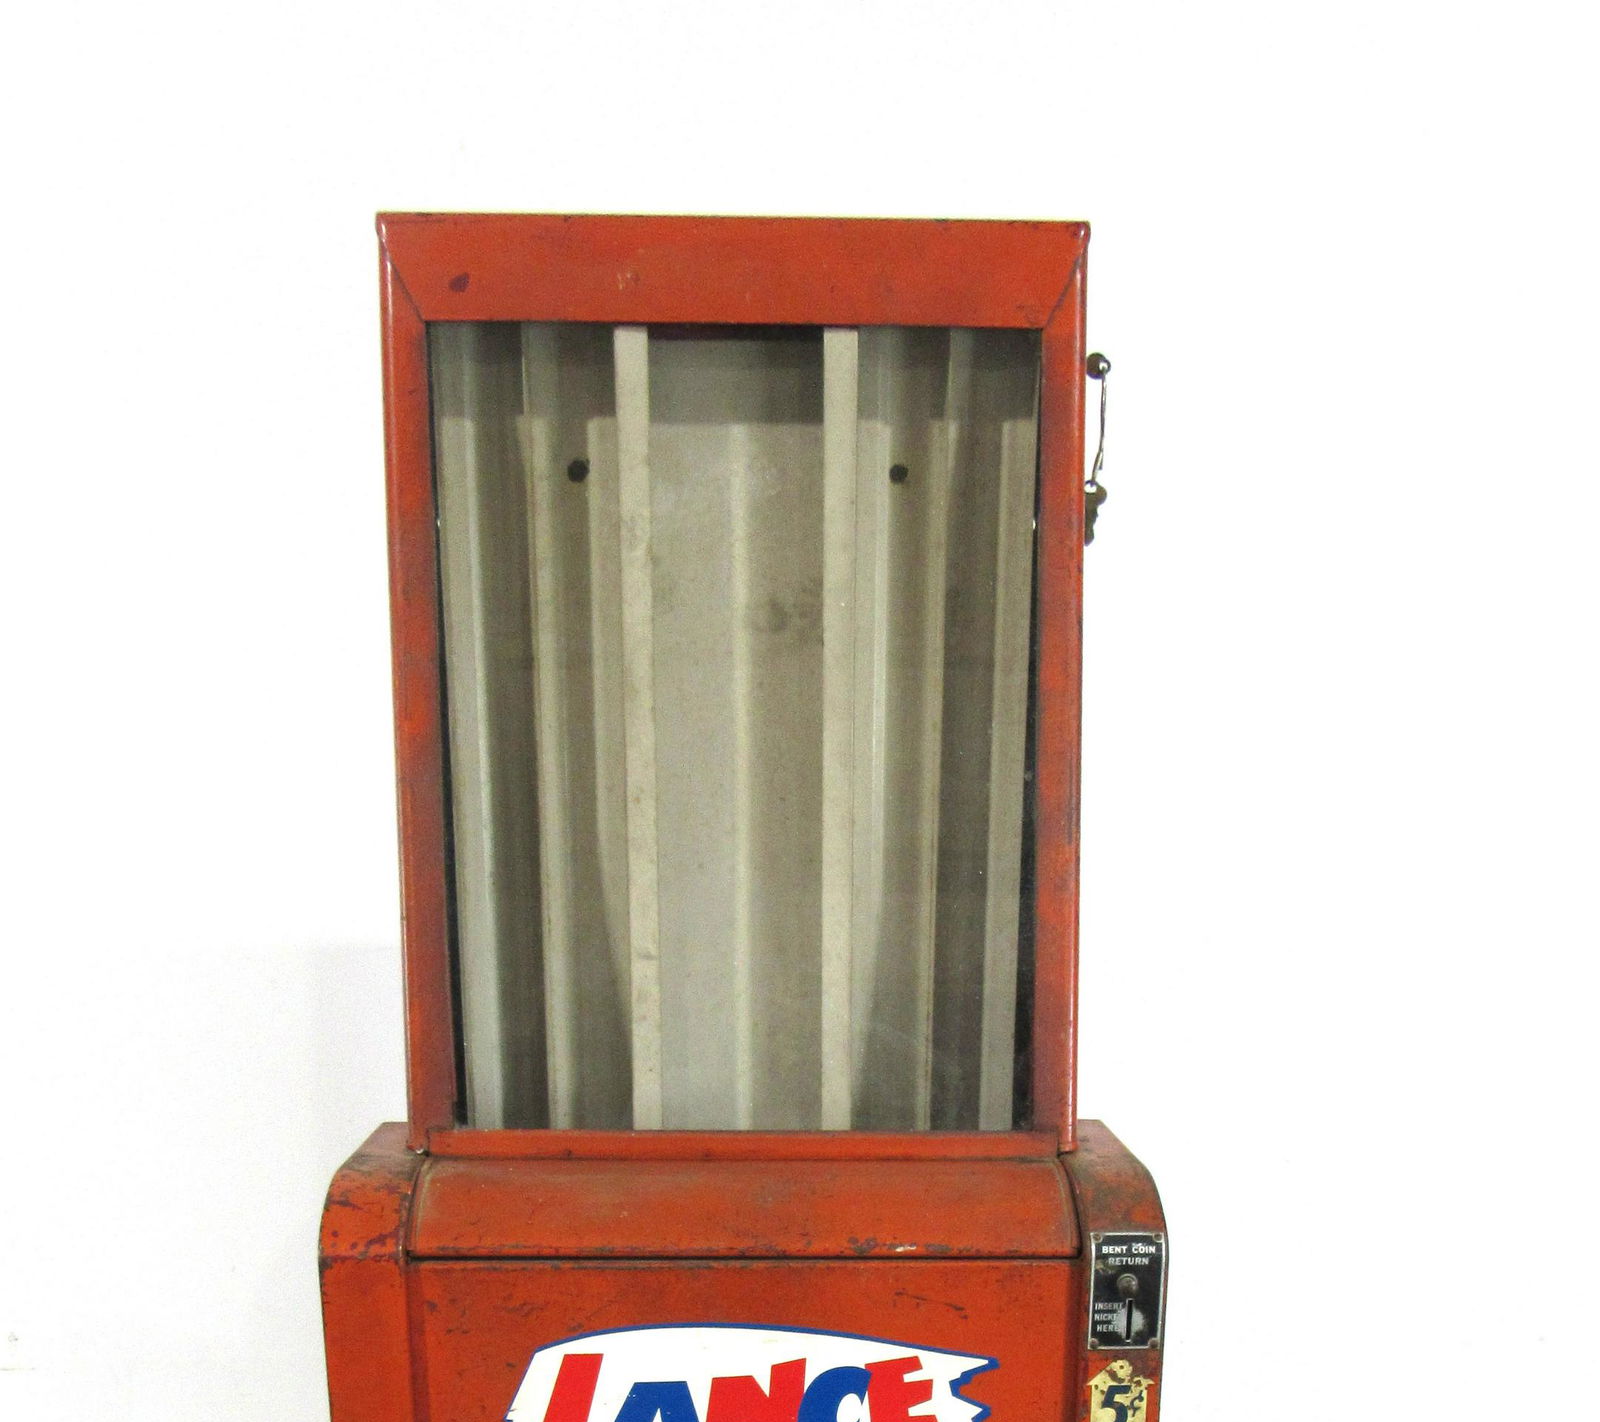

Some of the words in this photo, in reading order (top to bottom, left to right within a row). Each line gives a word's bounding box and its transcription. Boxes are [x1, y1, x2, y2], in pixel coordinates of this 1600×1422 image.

[1102, 1245, 1128, 1254] BENT
[1132, 1245, 1156, 1254] COIN
[1108, 1257, 1149, 1265] RETURN
[1094, 1302, 1123, 1310] INSERT
[1094, 1313, 1123, 1321] NICKE
